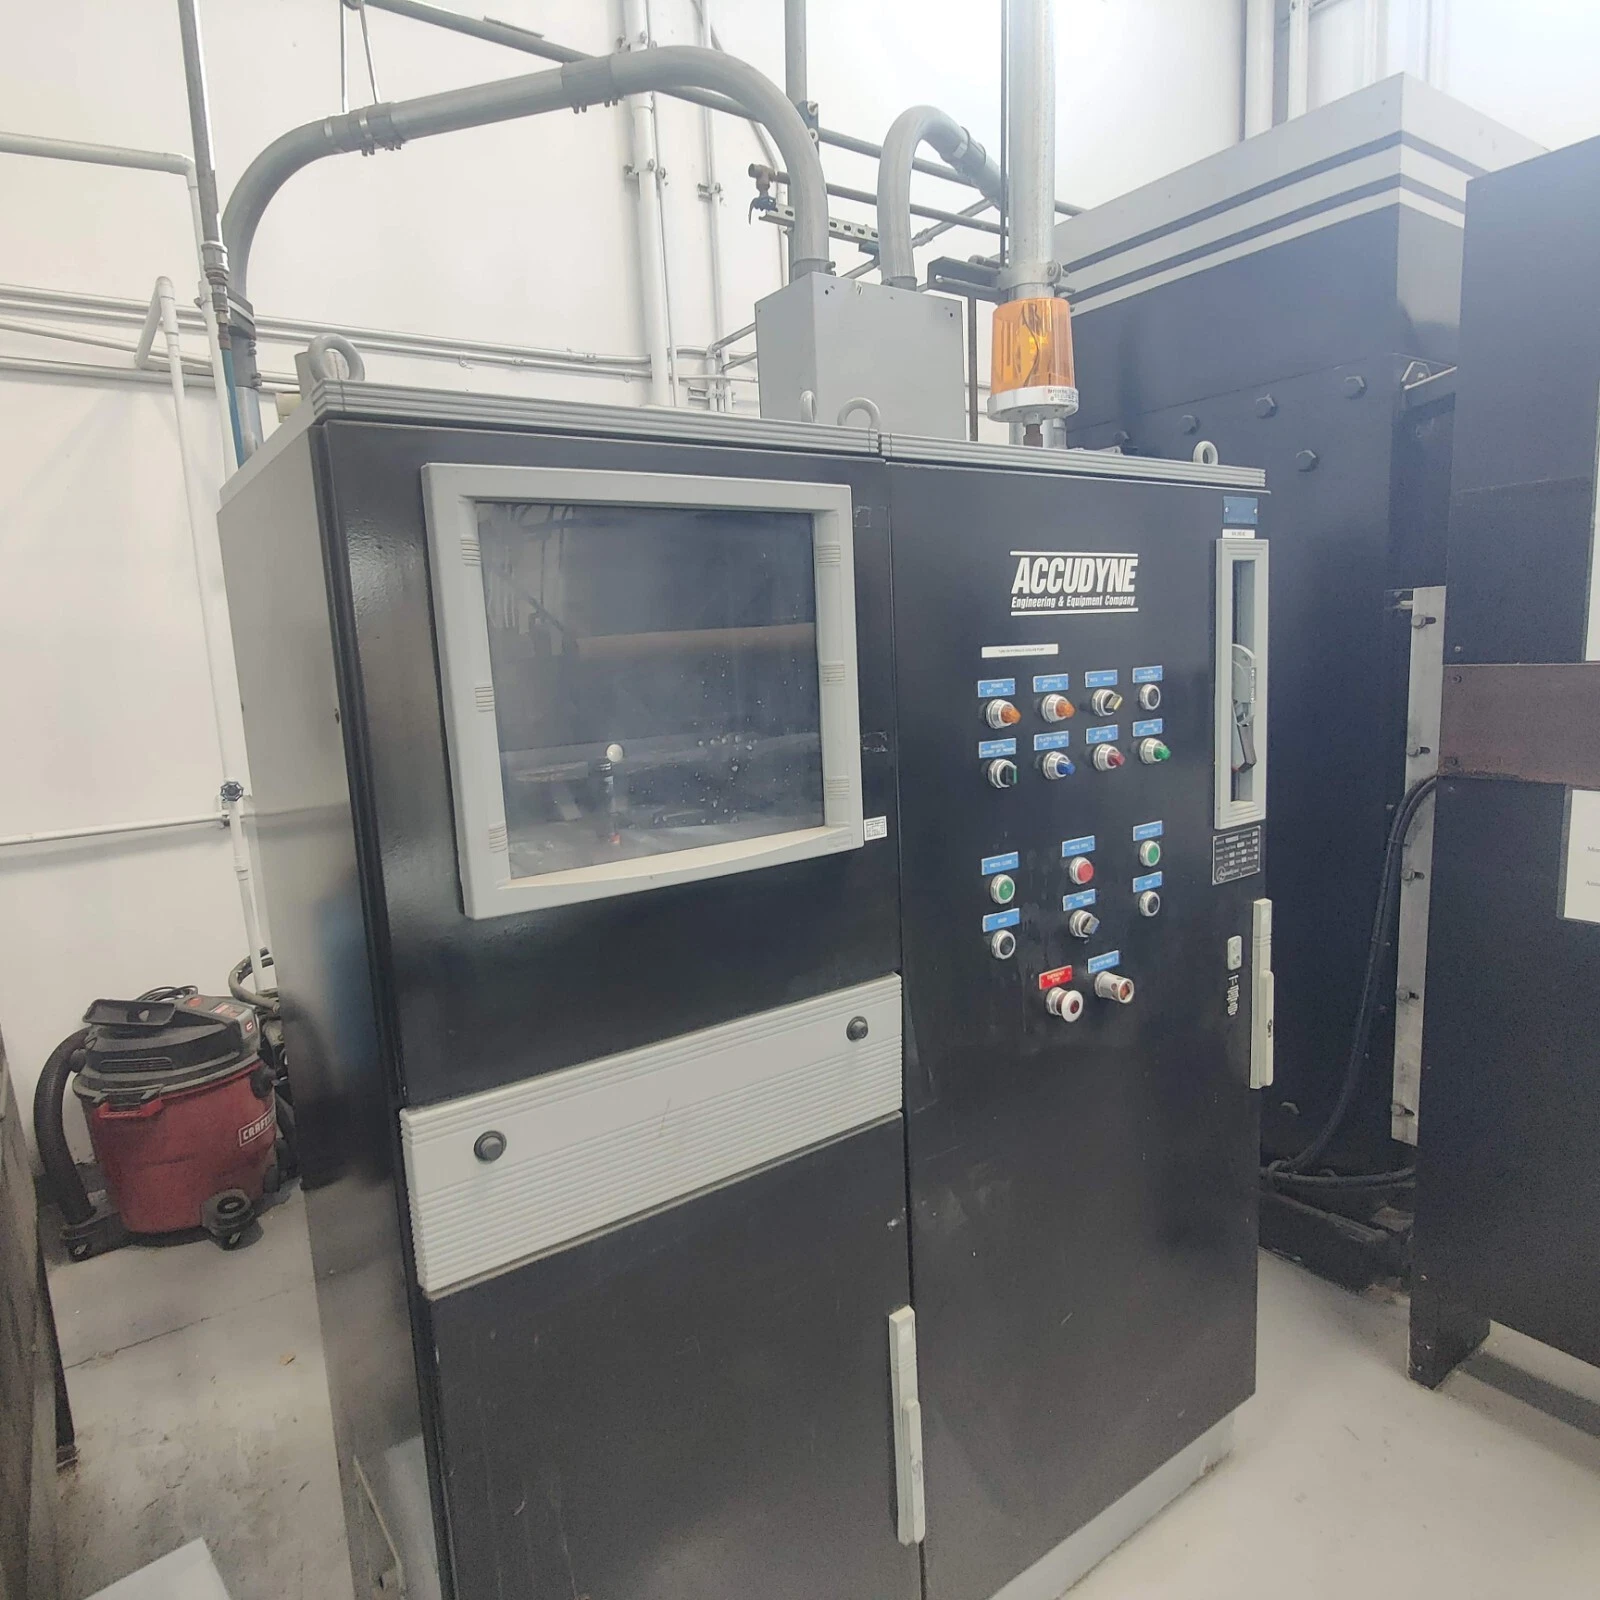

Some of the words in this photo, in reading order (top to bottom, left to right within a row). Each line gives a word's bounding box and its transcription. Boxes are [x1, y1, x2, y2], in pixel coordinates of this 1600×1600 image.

[1011, 557, 1139, 594] ACCUDYNE
[1011, 596, 1056, 609] Engineering
[1058, 596, 1064, 607] &
[1066, 595, 1103, 607] Equipment
[1104, 595, 1136, 606] Company
